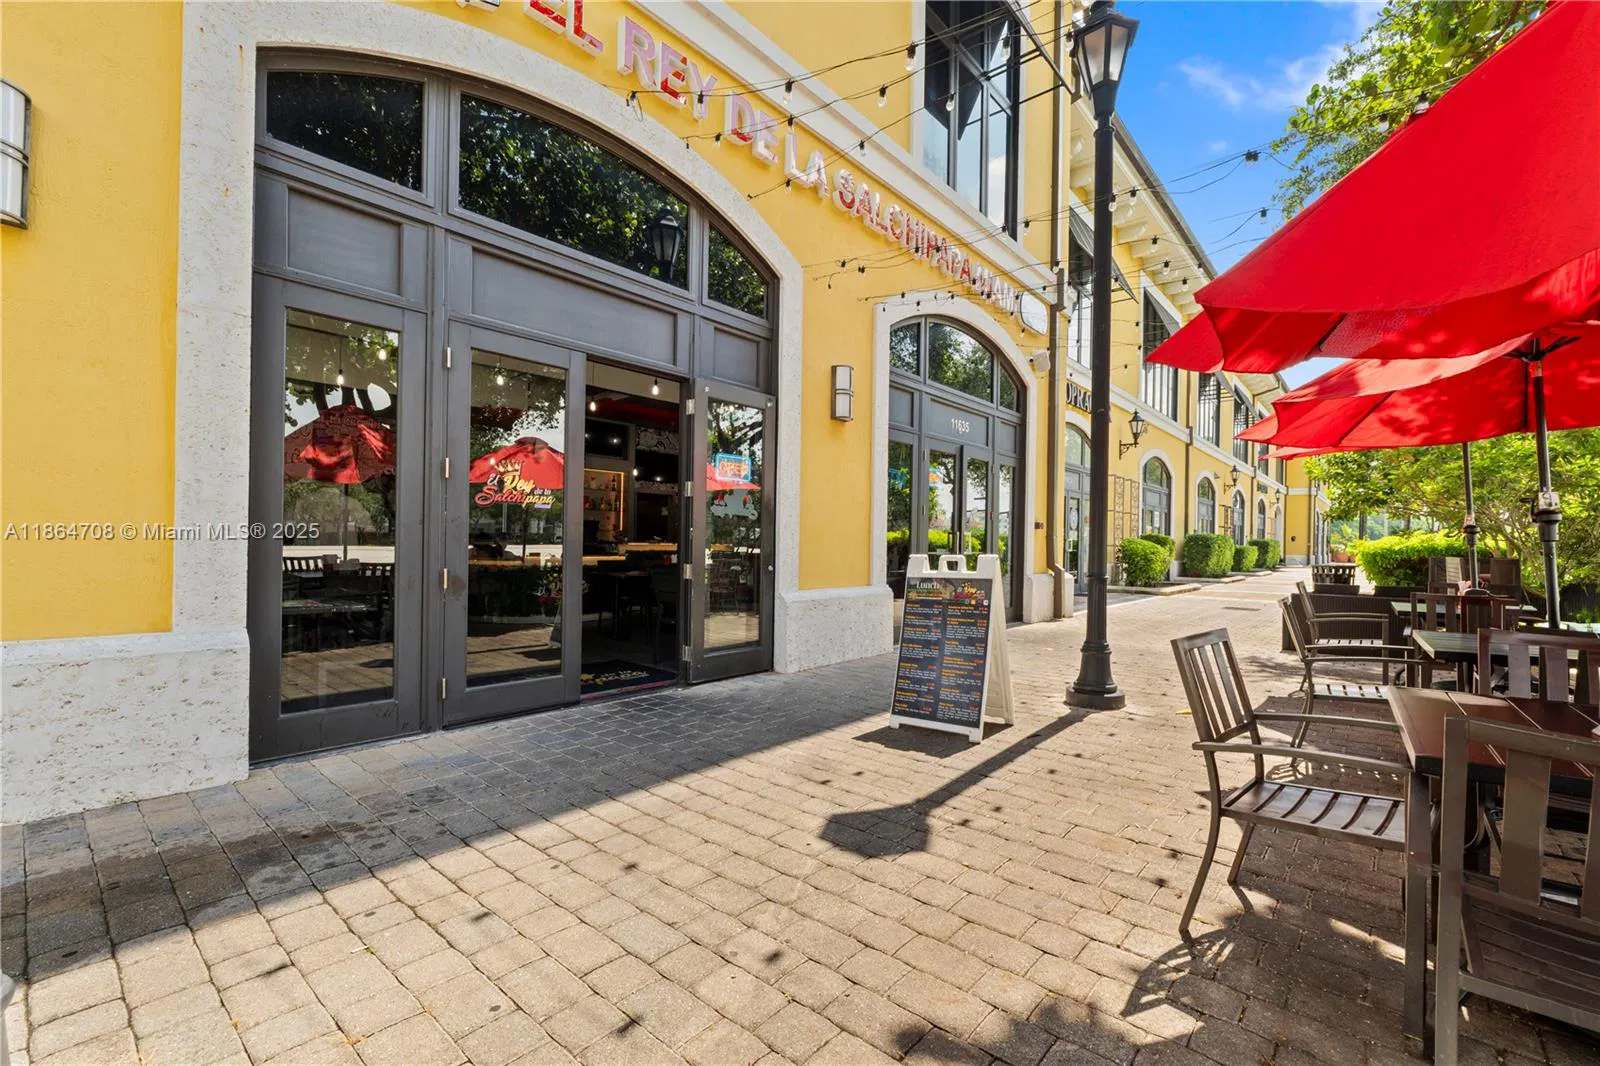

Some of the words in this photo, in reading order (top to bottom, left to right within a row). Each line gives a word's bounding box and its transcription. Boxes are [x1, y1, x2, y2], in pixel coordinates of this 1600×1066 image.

[617, 15, 718, 121] REY
[723, 91, 780, 167] DE
[783, 127, 830, 200] LA
[832, 168, 973, 288] SALCHIPAPA
[503, 474, 536, 494] Rey
[534, 487, 543, 495] de
[474, 485, 556, 508] Salchipapa
[916, 581, 940, 590] Lunch
